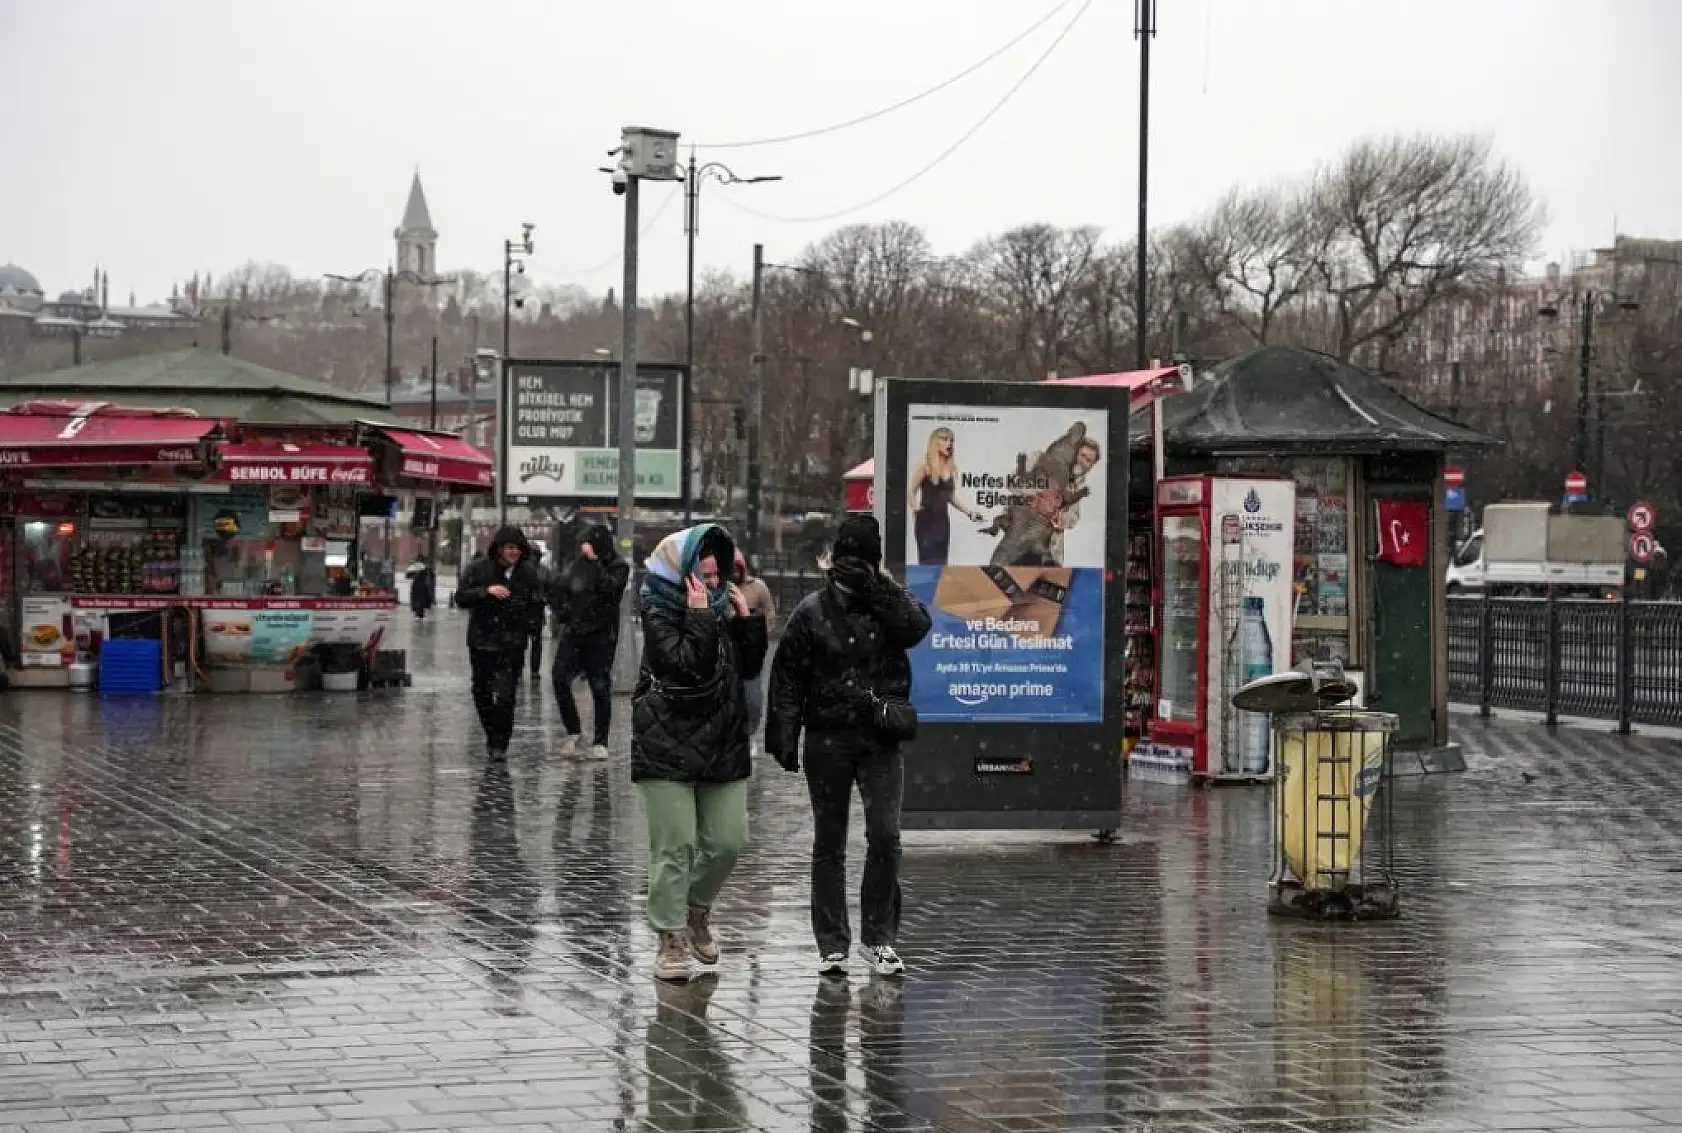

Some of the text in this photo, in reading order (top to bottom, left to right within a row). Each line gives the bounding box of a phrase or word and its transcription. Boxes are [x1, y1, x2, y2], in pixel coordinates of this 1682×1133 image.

[518, 375, 543, 389] HEM
[569, 393, 592, 407] HEM
[518, 425, 574, 440] OLUR MU?
[230, 466, 288, 480] SEMBOL
[290, 464, 328, 480] BÜFE
[961, 472, 1050, 489] Nefes Kesici
[976, 490, 1034, 508] Eğlence
[966, 617, 1040, 632] ve Bedava
[931, 633, 1073, 650] Ertesi Gün Teslimat
[949, 680, 1053, 699] amazon prime
